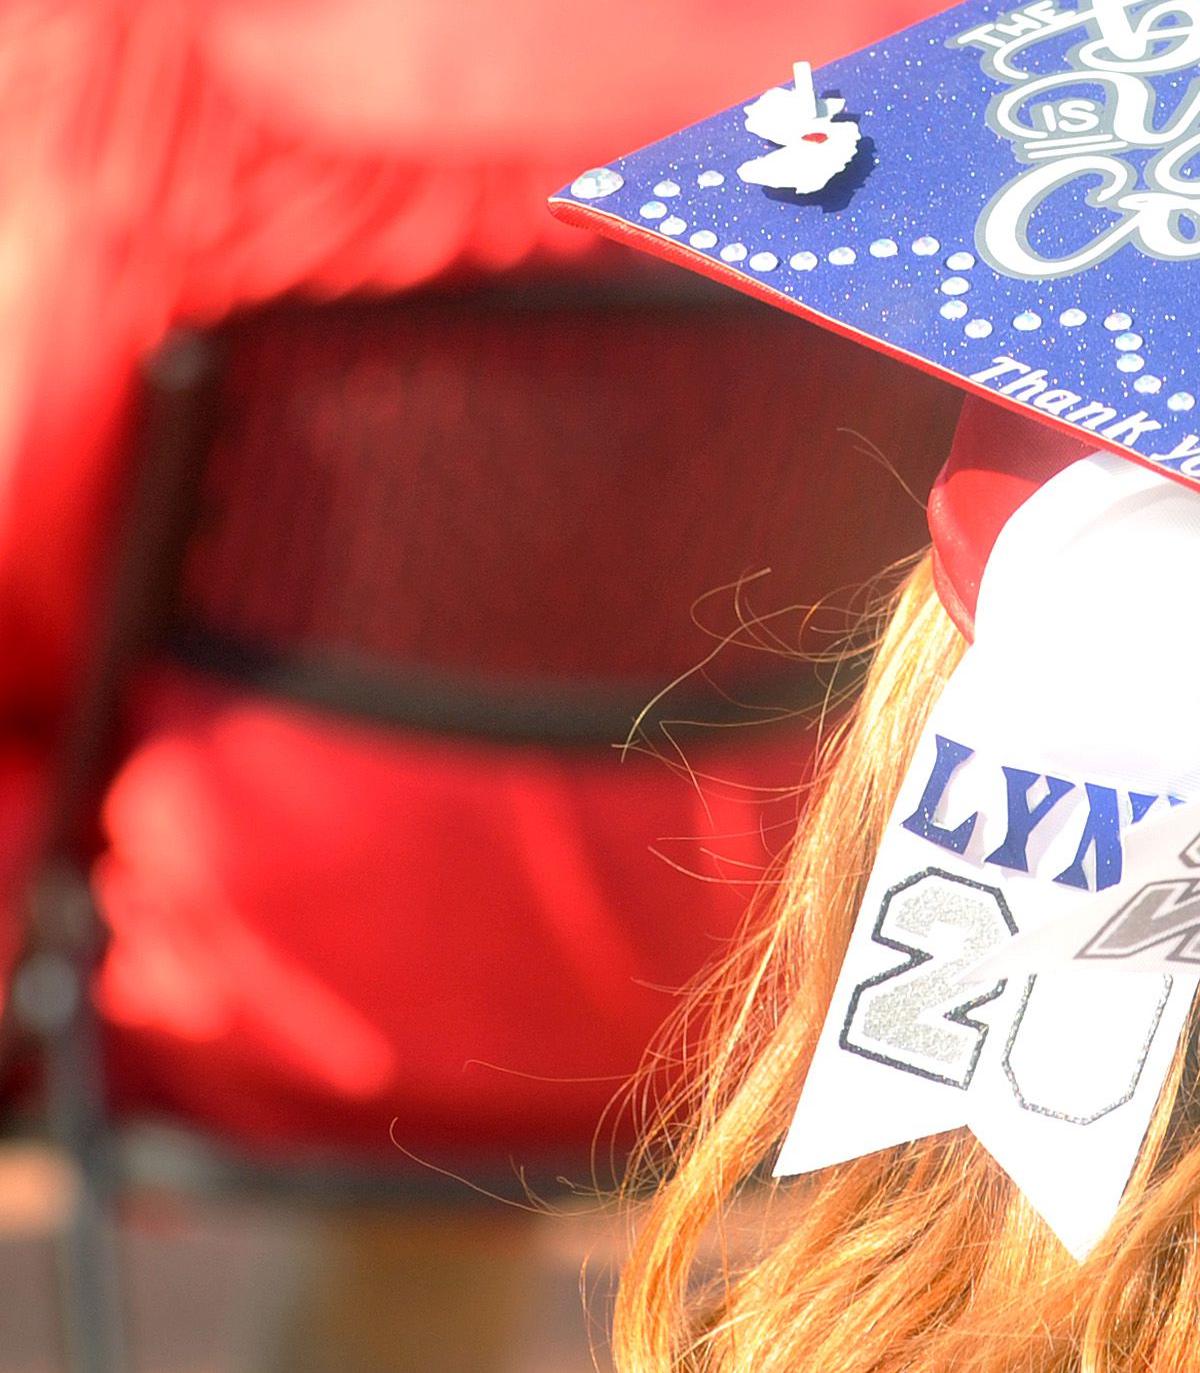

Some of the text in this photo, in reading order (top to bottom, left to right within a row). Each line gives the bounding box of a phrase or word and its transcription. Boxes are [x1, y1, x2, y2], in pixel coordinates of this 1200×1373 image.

[956, 0, 1077, 49] THE
[1042, 99, 1100, 133] IS
[901, 734, 1187, 892] LYN
